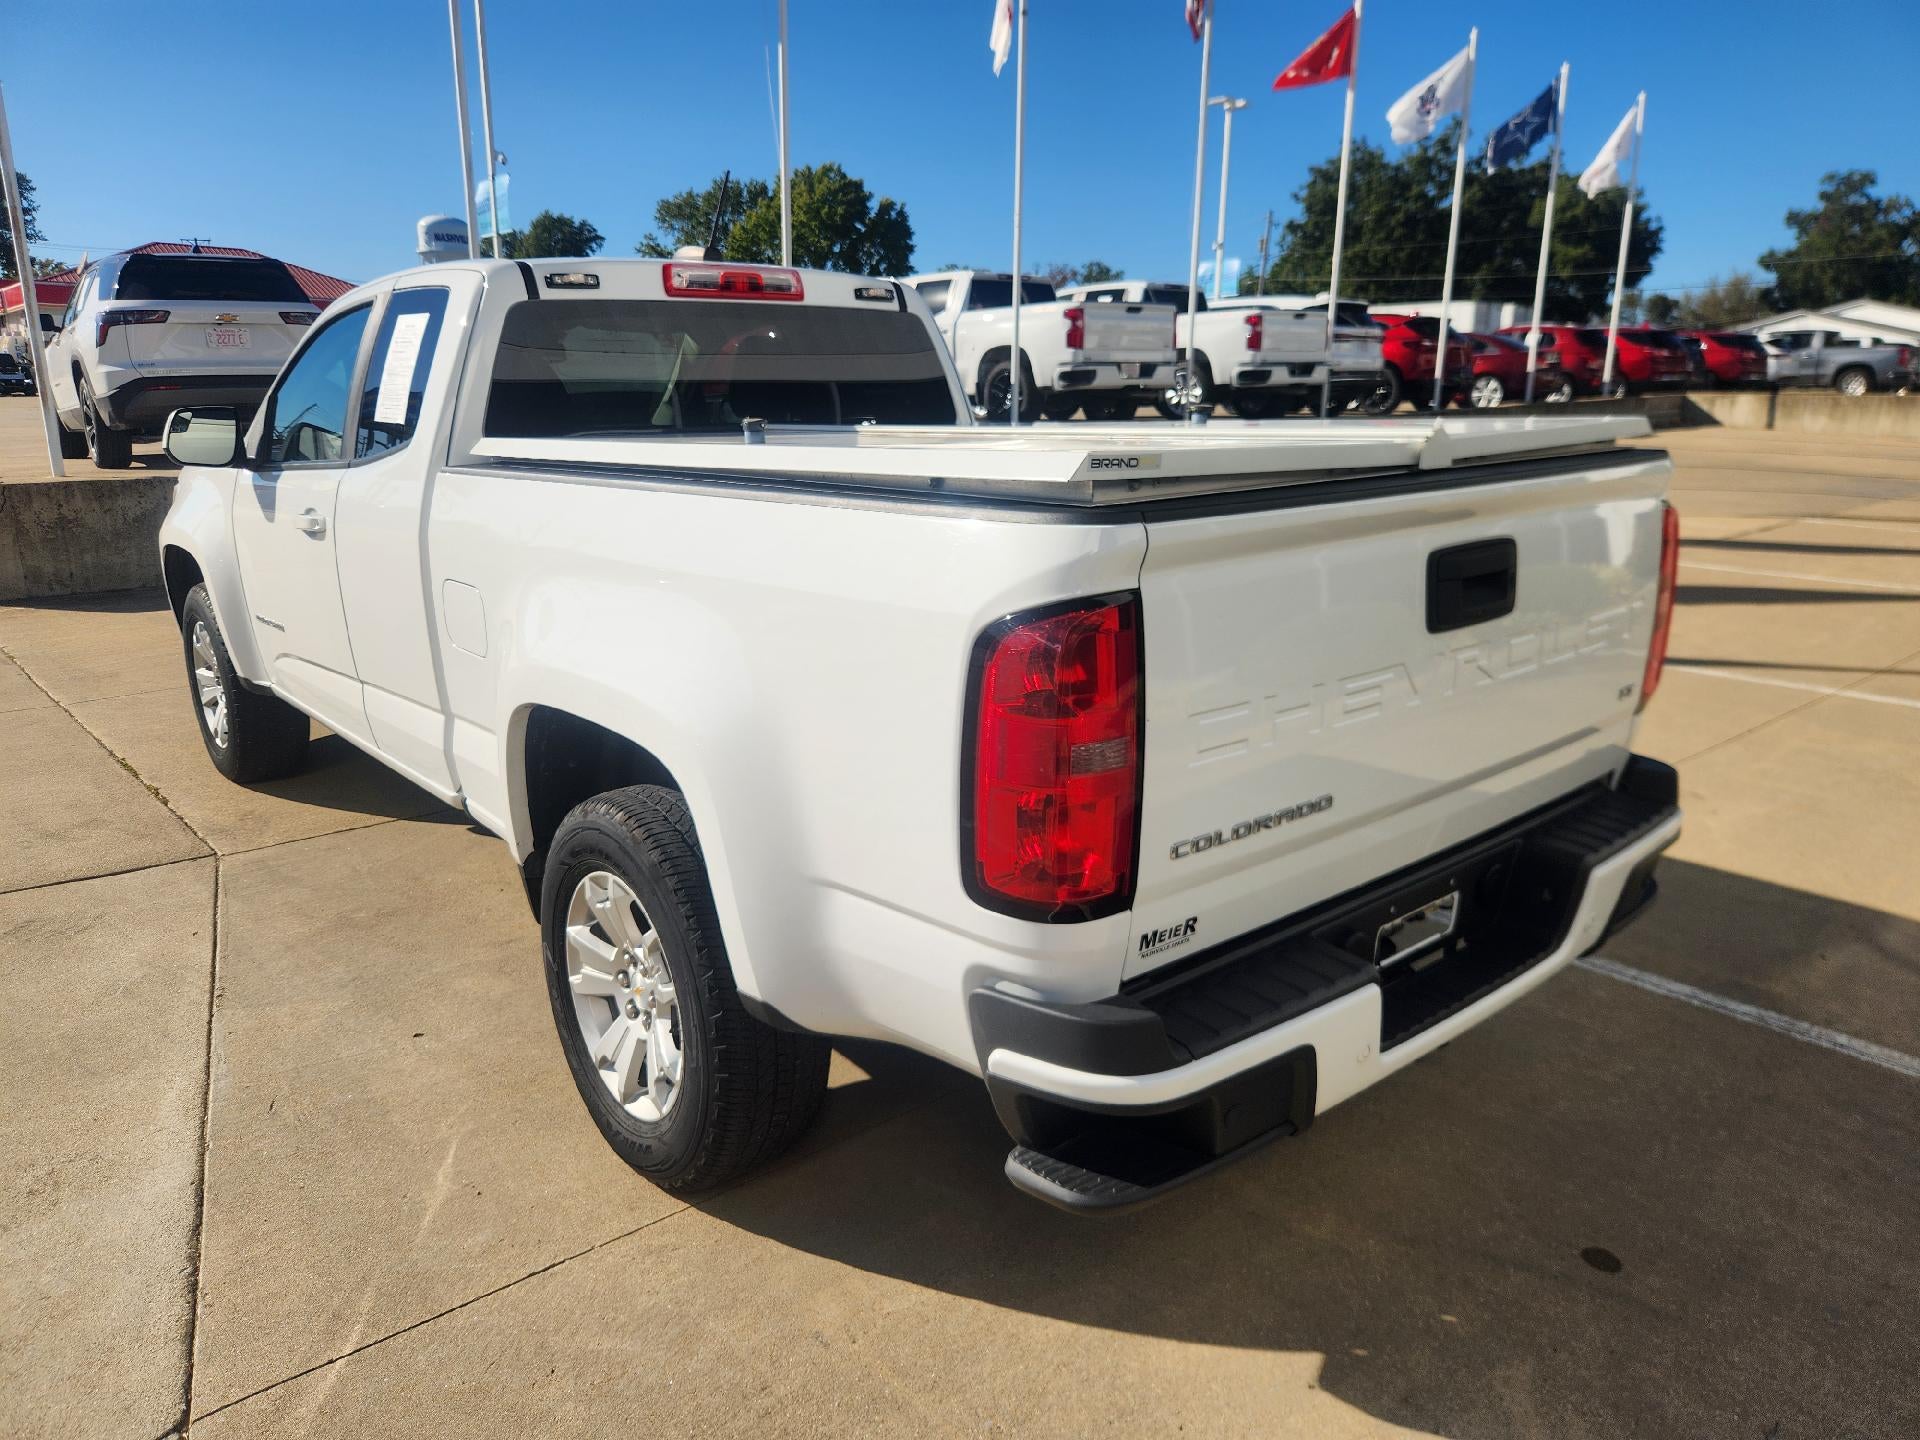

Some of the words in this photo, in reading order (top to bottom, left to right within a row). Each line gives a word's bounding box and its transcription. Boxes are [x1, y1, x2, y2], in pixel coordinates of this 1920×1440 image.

[1090, 457, 1139, 469] BRAND
[1188, 601, 1645, 767] CHEVROLET
[1169, 793, 1333, 860] COLORADO
